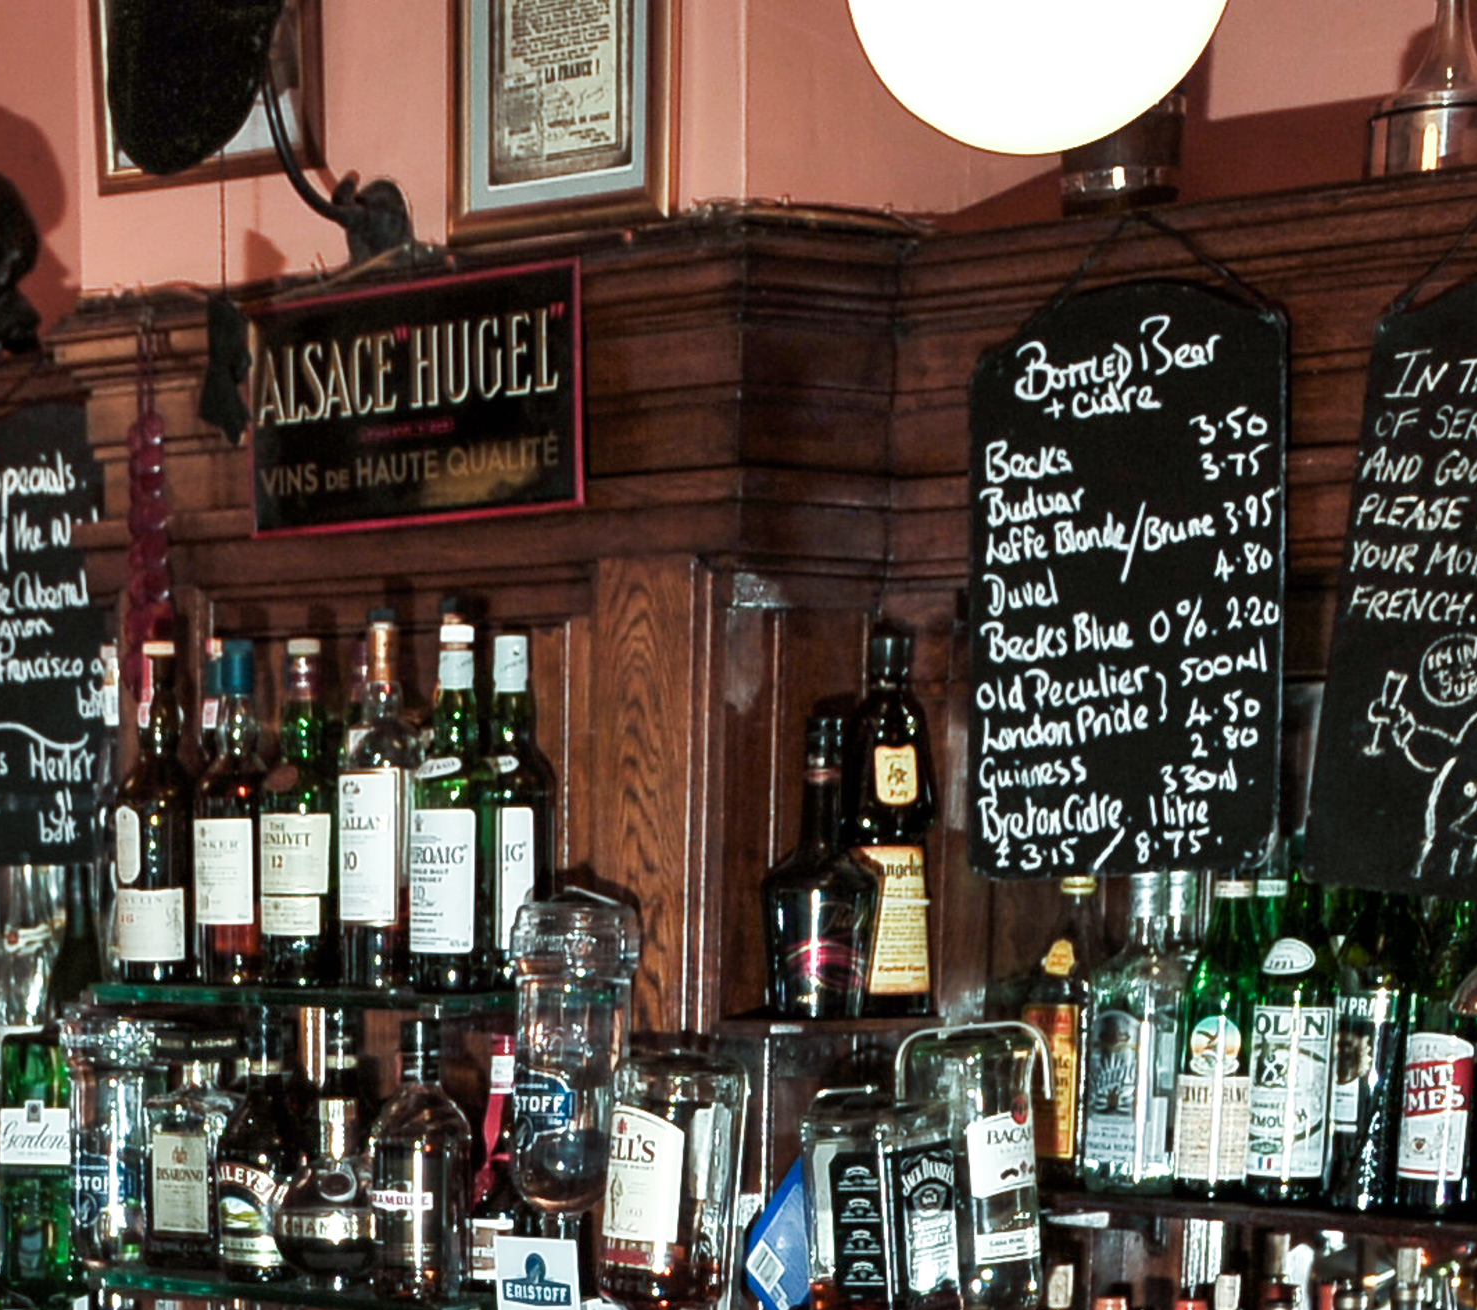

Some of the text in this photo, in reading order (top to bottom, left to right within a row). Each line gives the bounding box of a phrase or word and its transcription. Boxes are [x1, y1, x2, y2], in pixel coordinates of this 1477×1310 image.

[258, 332, 398, 427] ALSACE
[1383, 349, 1449, 399] IN
[1374, 406, 1422, 438] OF
[260, 461, 320, 497] VINS
[324, 469, 349, 490] DE
[355, 449, 439, 489] HAUTE
[446, 430, 559, 473] QUALITÉ
[984, 439, 1074, 483] Becks
[1360, 445, 1423, 484] AND
[978, 485, 1085, 528] Budvar
[1356, 492, 1471, 531] PLEASE
[985, 523, 1050, 566] Leffe
[1348, 540, 1420, 574] YOUR
[982, 566, 1060, 617] Duvel
[979, 619, 1069, 664] Becks
[1071, 610, 1135, 653] Blue
[975, 667, 1027, 713] Old
[1023, 662, 1151, 711] Peculier
[980, 710, 1075, 755] London
[1075, 698, 1150, 744] Pride
[977, 755, 1089, 803] Guinness
[977, 796, 1063, 846] Breton
[271, 853, 284, 869] 12
[505, 1282, 568, 1303] ERISTOFF
